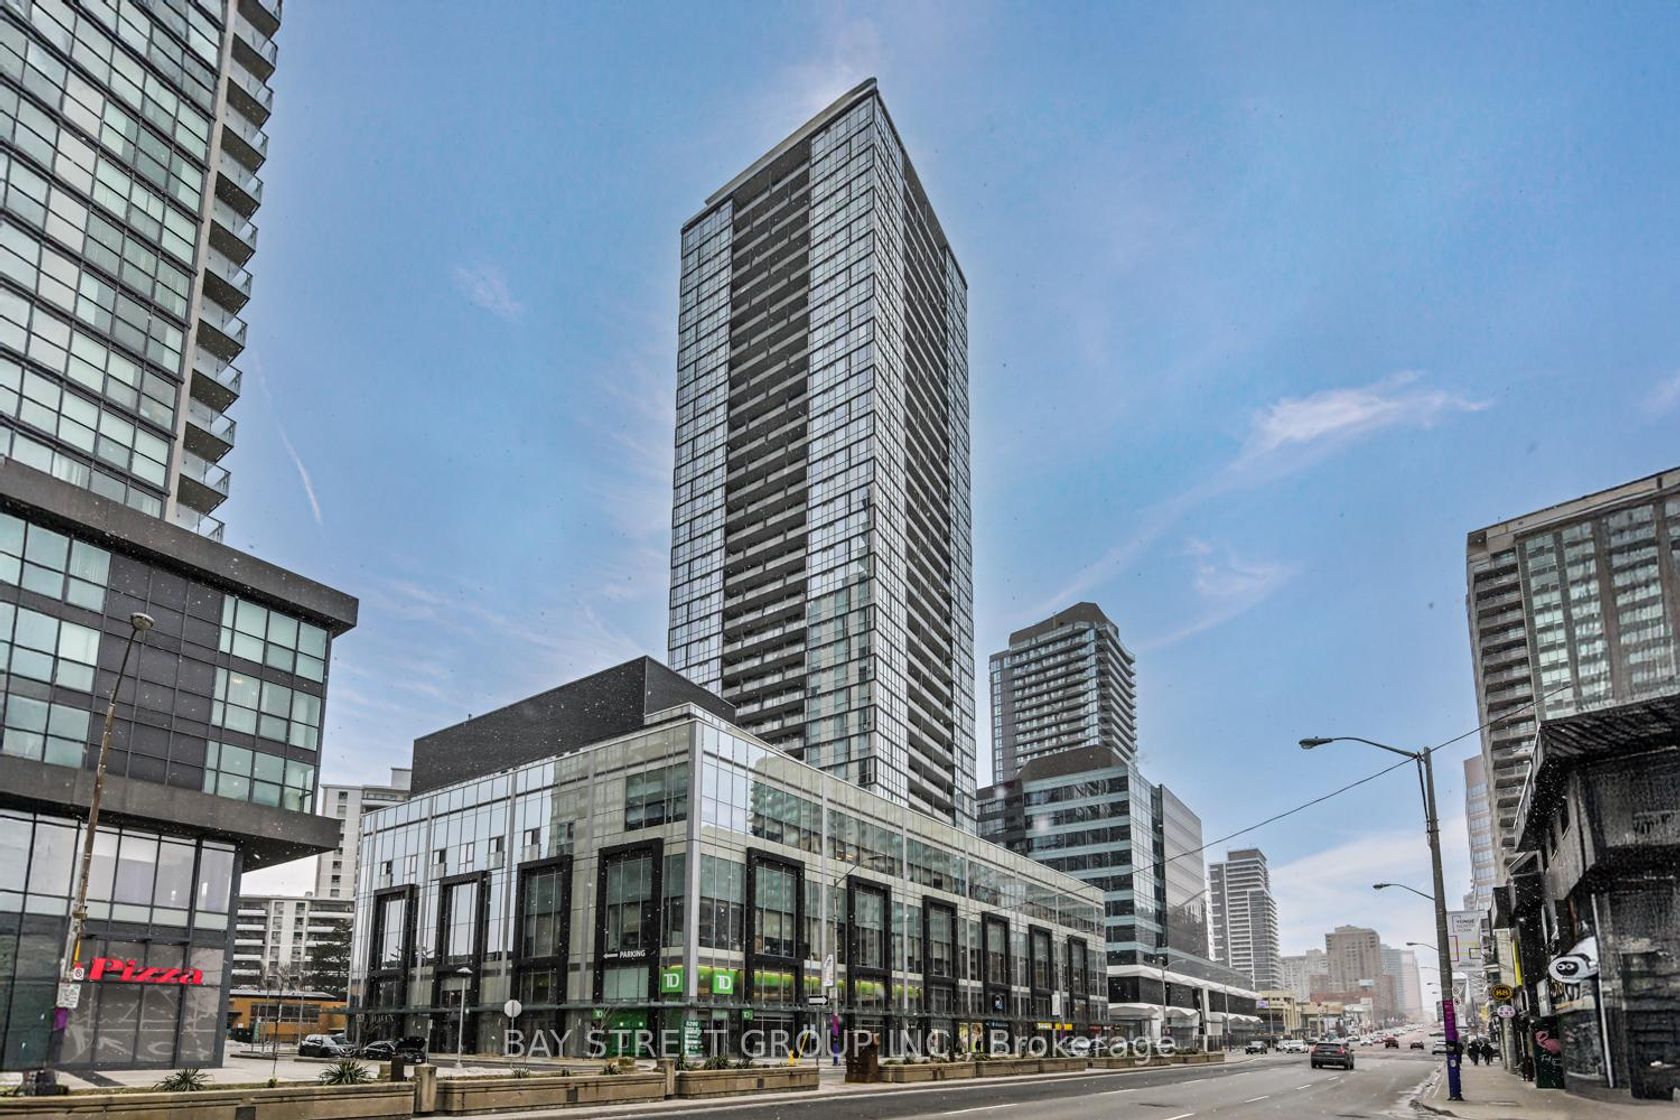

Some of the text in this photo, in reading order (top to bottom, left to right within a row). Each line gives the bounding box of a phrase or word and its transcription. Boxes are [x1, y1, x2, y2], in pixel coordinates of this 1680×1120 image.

[619, 950, 646, 959] PARKING
[88, 957, 203, 985] Pizza
[664, 973, 680, 988] TD
[716, 975, 732, 990] TD
